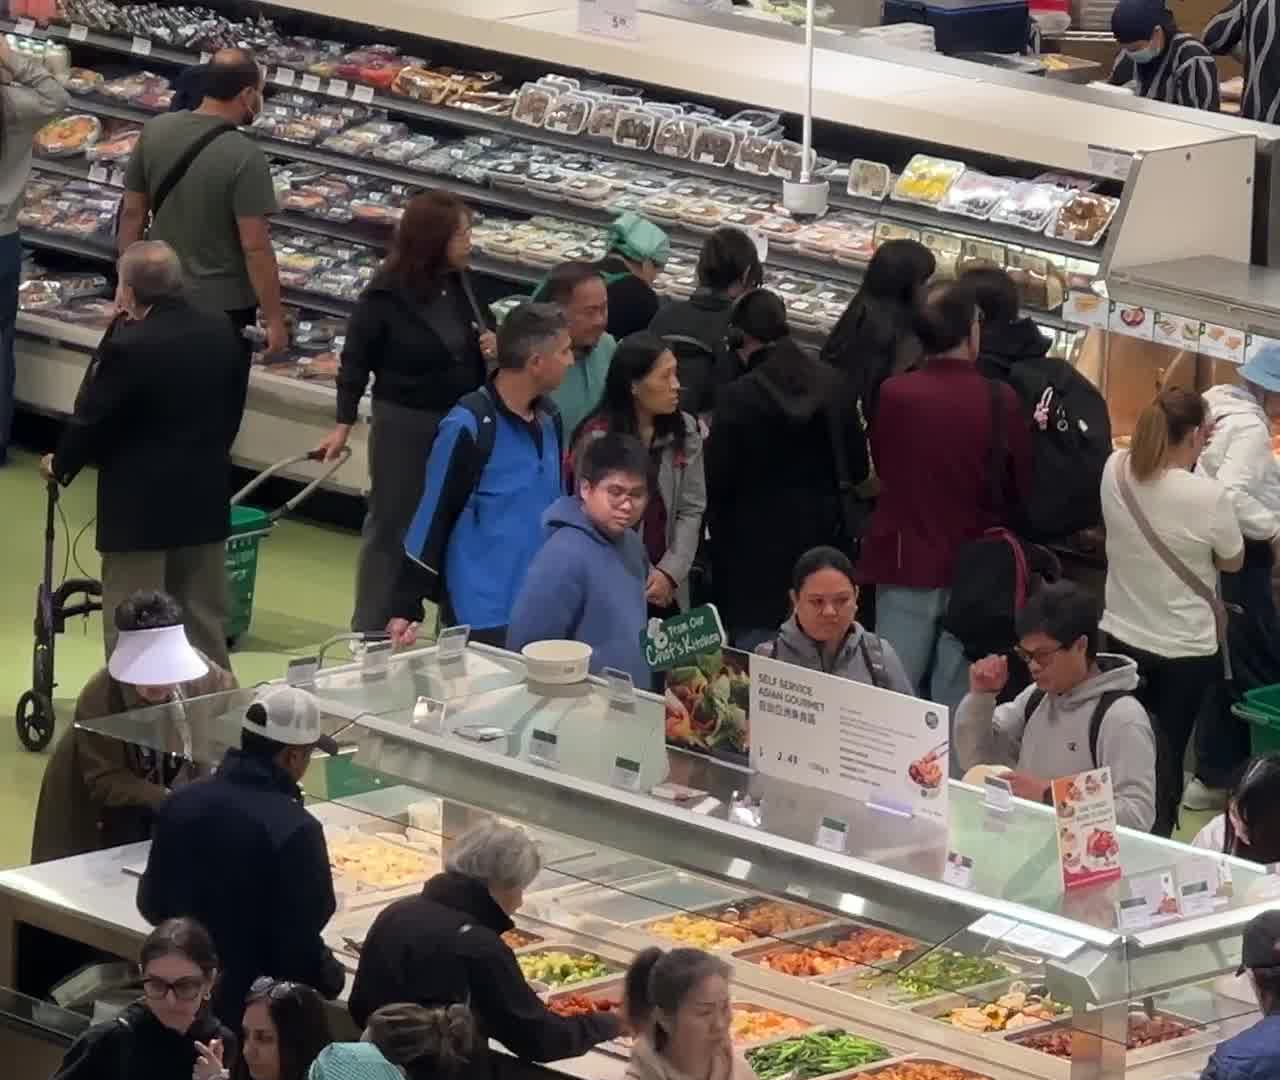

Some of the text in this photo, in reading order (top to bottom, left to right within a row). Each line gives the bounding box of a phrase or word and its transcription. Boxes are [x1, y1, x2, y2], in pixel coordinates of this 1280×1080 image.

[758, 672, 814, 698] SELF SERVICE
[758, 687, 825, 713] ASIAN GOURMET
